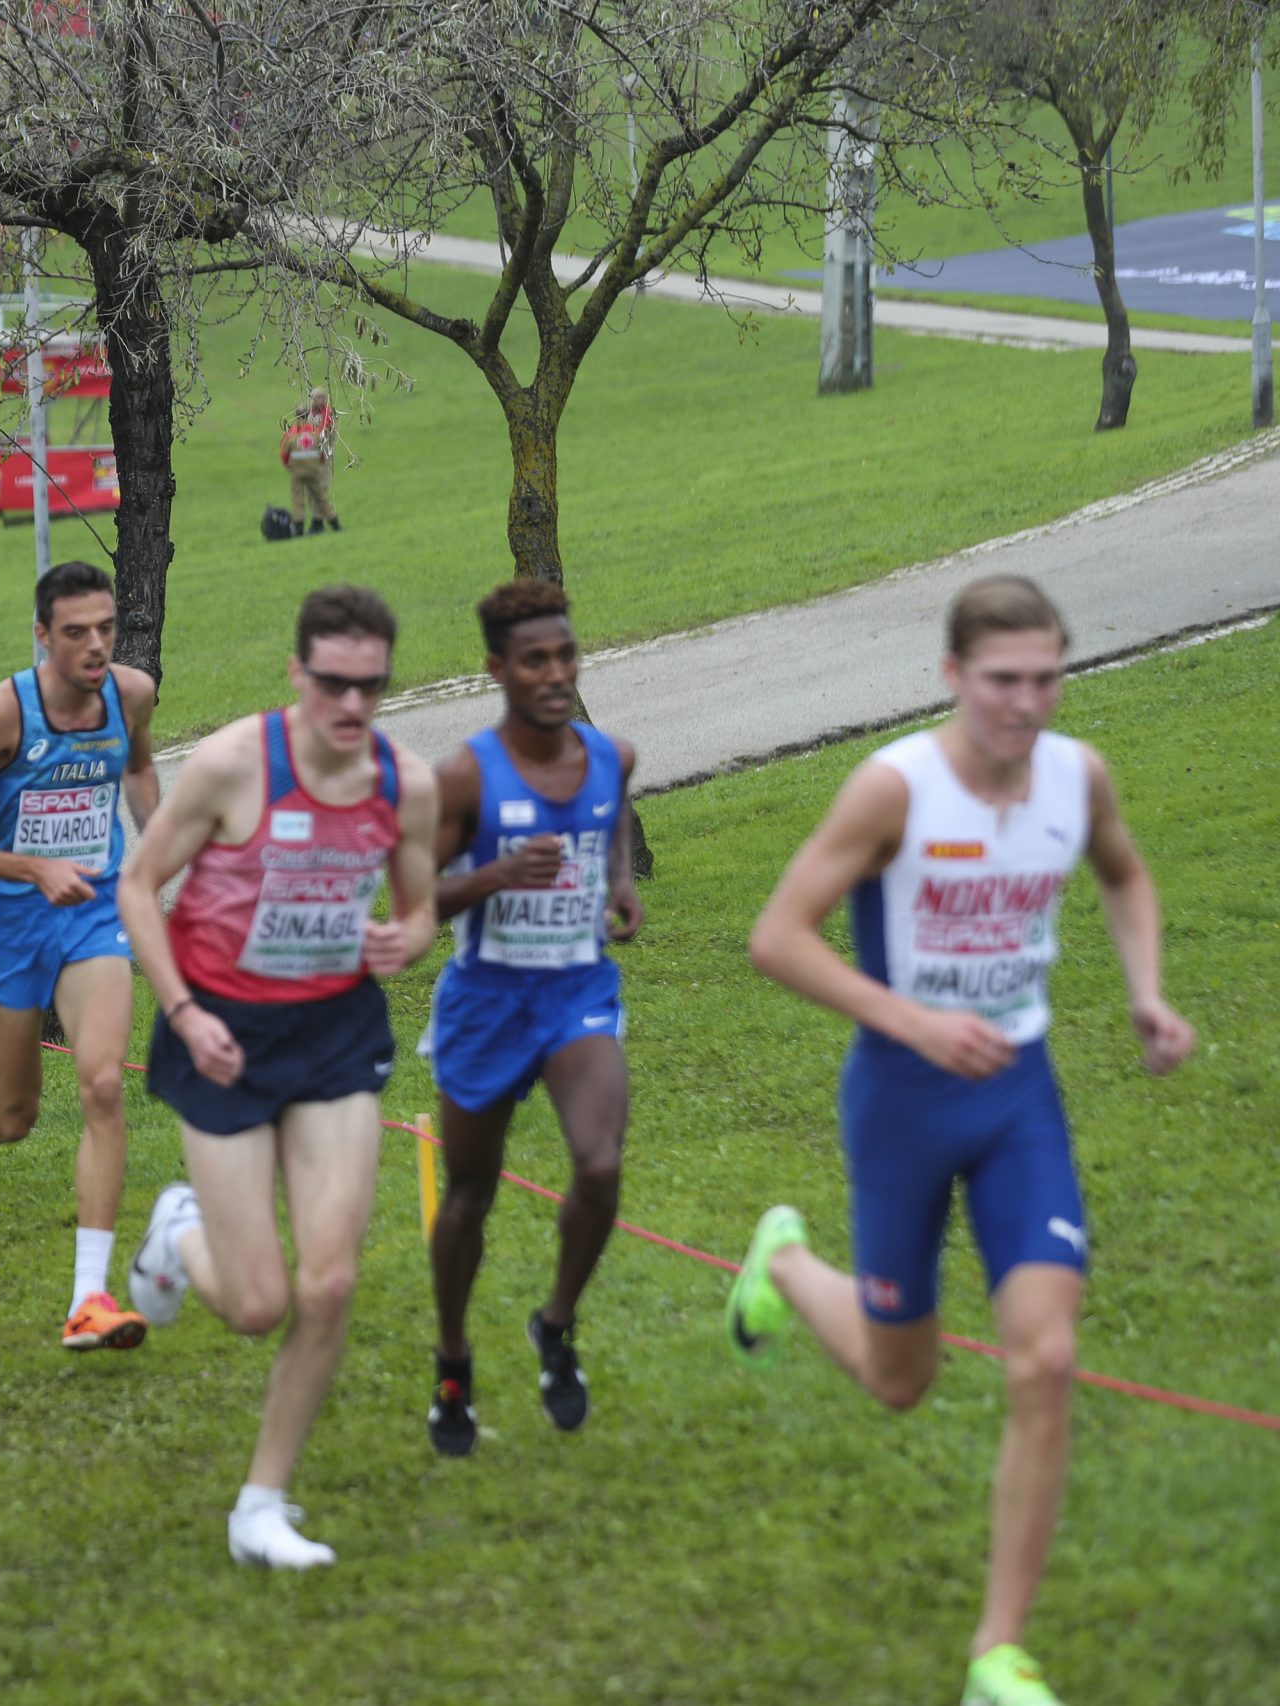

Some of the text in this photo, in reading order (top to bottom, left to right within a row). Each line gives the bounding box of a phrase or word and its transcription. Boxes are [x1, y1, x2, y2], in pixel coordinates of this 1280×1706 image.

[51, 759, 107, 781] ITALIA
[23, 791, 92, 813] SPAR
[19, 811, 108, 845] SELVAROLO
